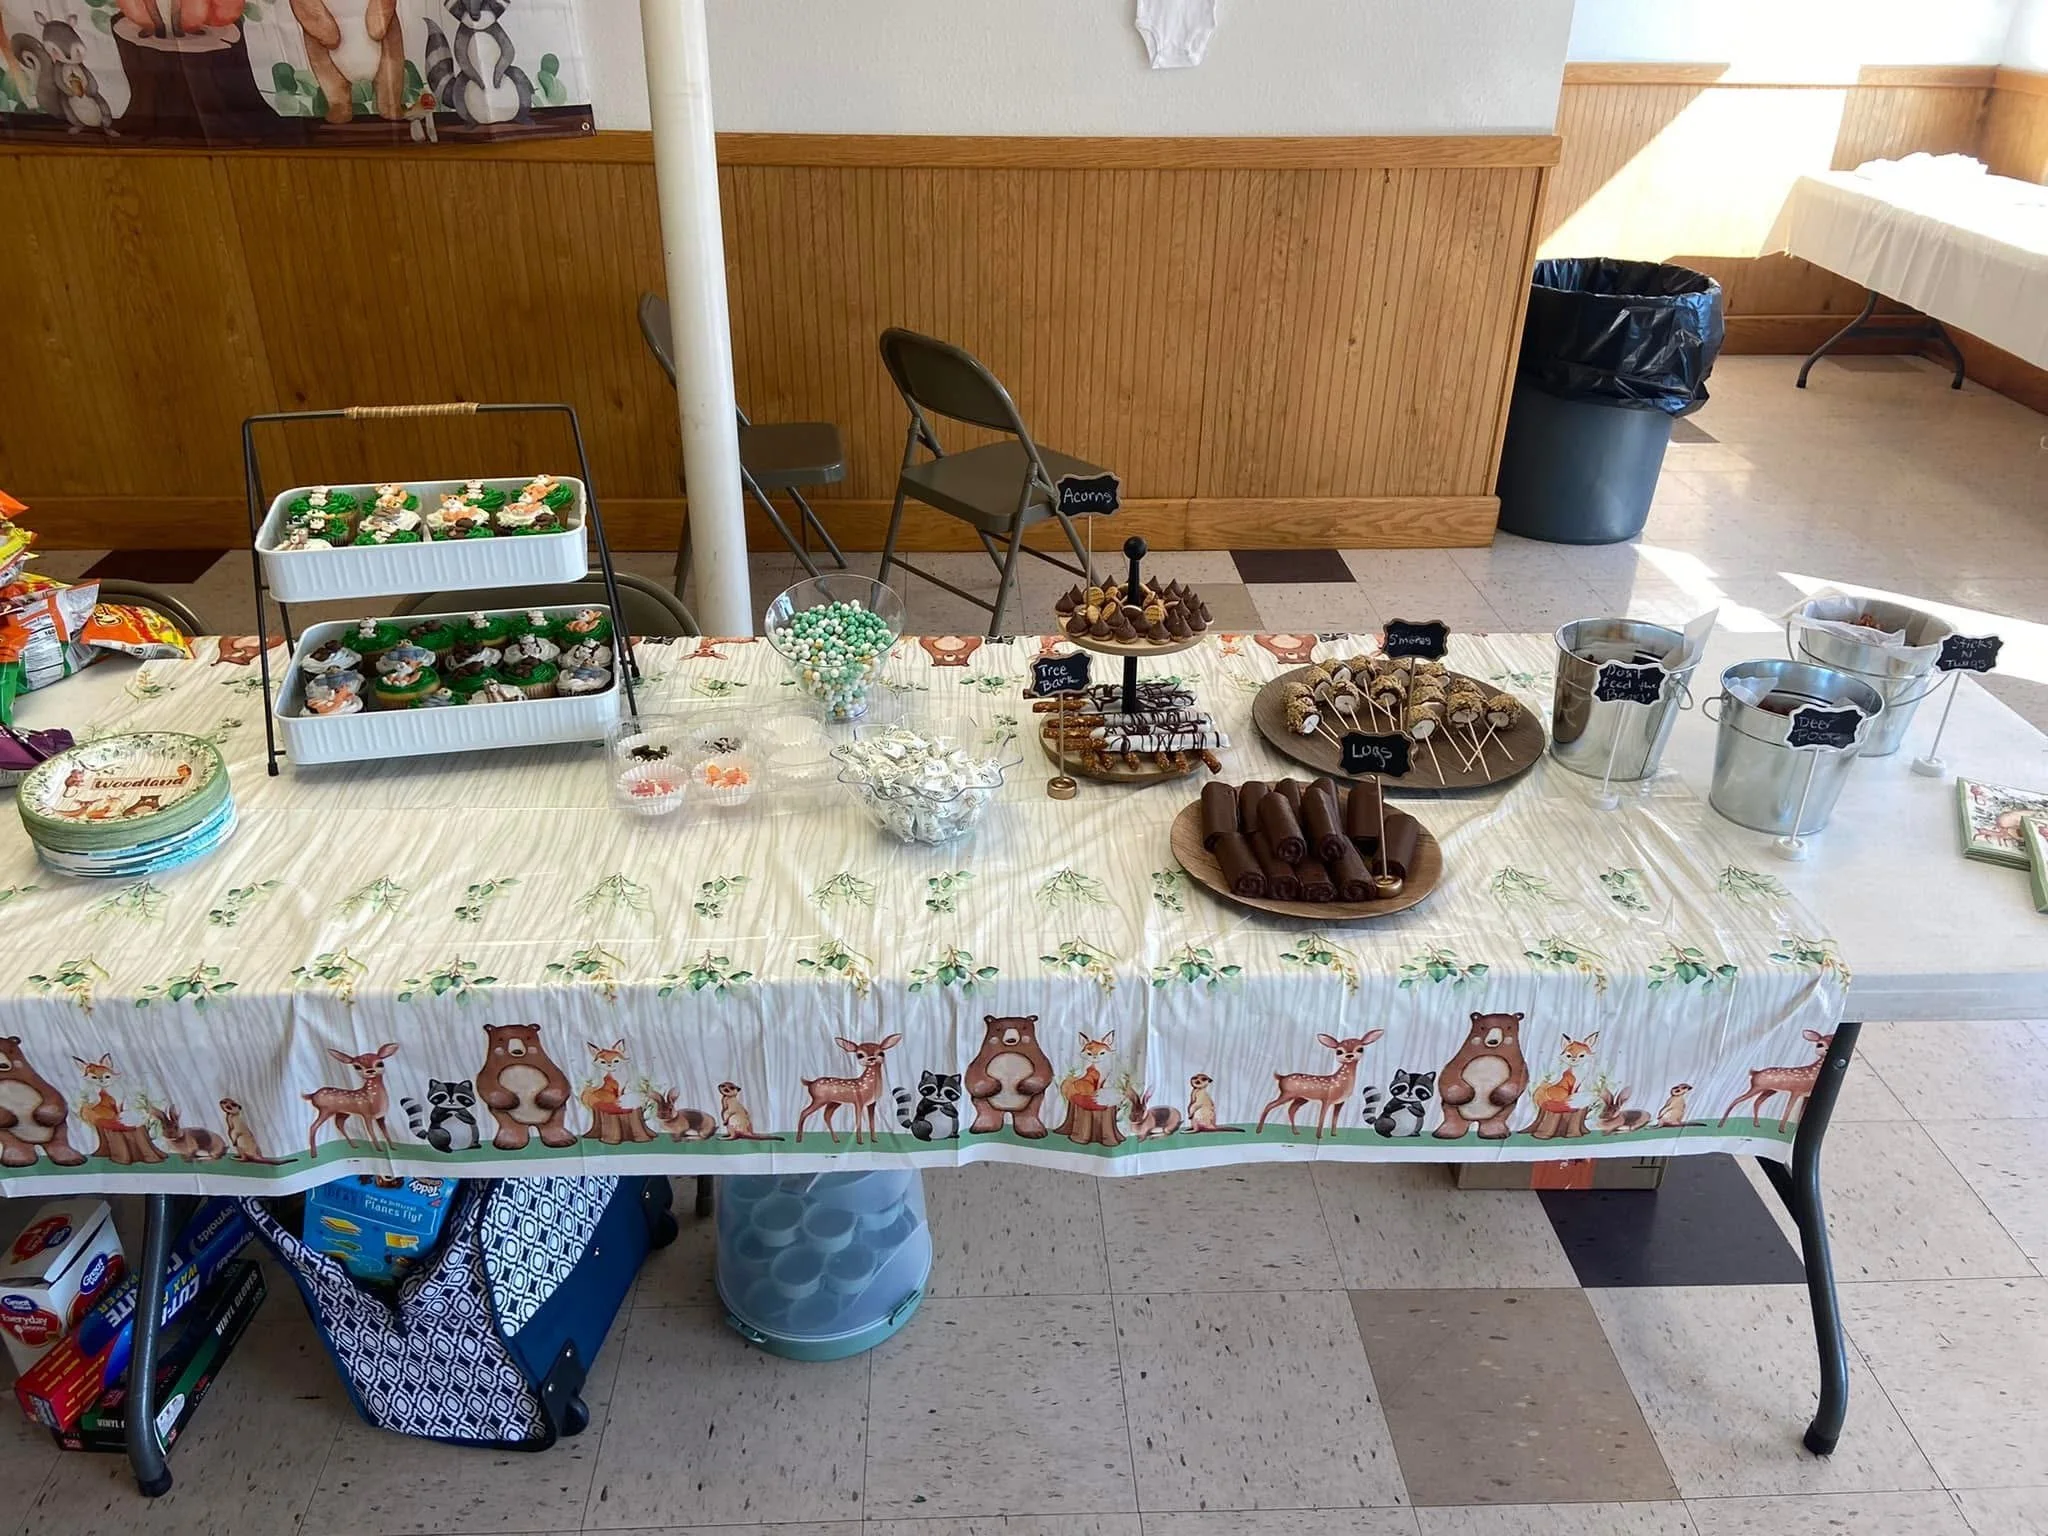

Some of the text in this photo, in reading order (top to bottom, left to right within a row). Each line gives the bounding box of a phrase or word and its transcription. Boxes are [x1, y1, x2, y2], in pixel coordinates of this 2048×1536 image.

[1063, 487, 1113, 504] Acorns
[1038, 664, 1068, 677] Tree
[1040, 675, 1080, 692] Bark
[1639, 681, 1658, 691] the
[1799, 716, 1836, 730] Deer
[1352, 743, 1393, 768] Logs
[95, 775, 186, 789] Woodland
[408, 1180, 439, 1197] Teddy
[364, 1199, 401, 1217] Planes
